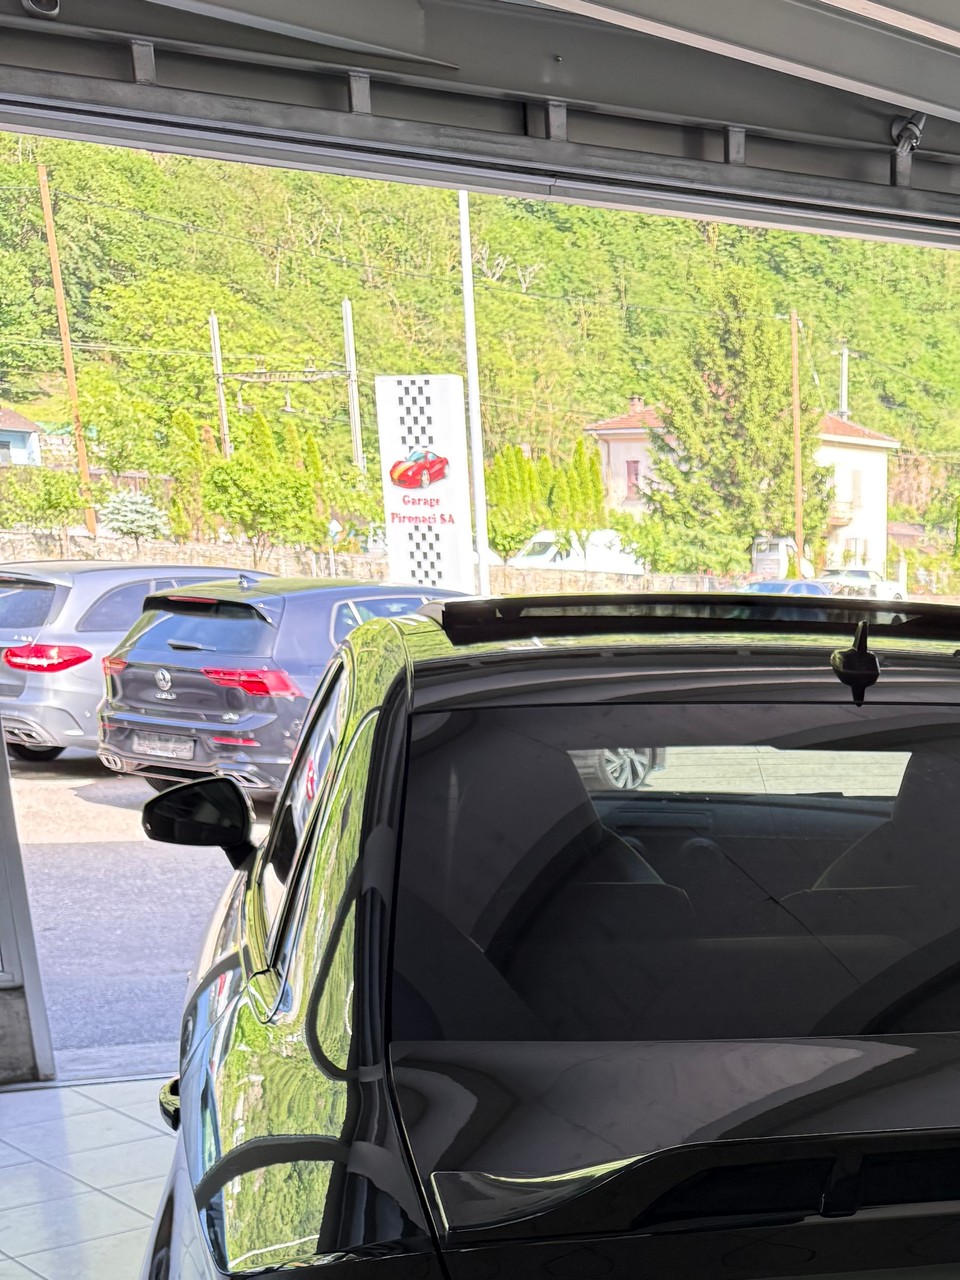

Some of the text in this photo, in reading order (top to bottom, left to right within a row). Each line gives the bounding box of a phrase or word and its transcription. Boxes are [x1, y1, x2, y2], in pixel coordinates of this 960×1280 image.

[402, 494, 441, 508] Garage
[390, 512, 455, 525] Pironaci SA
